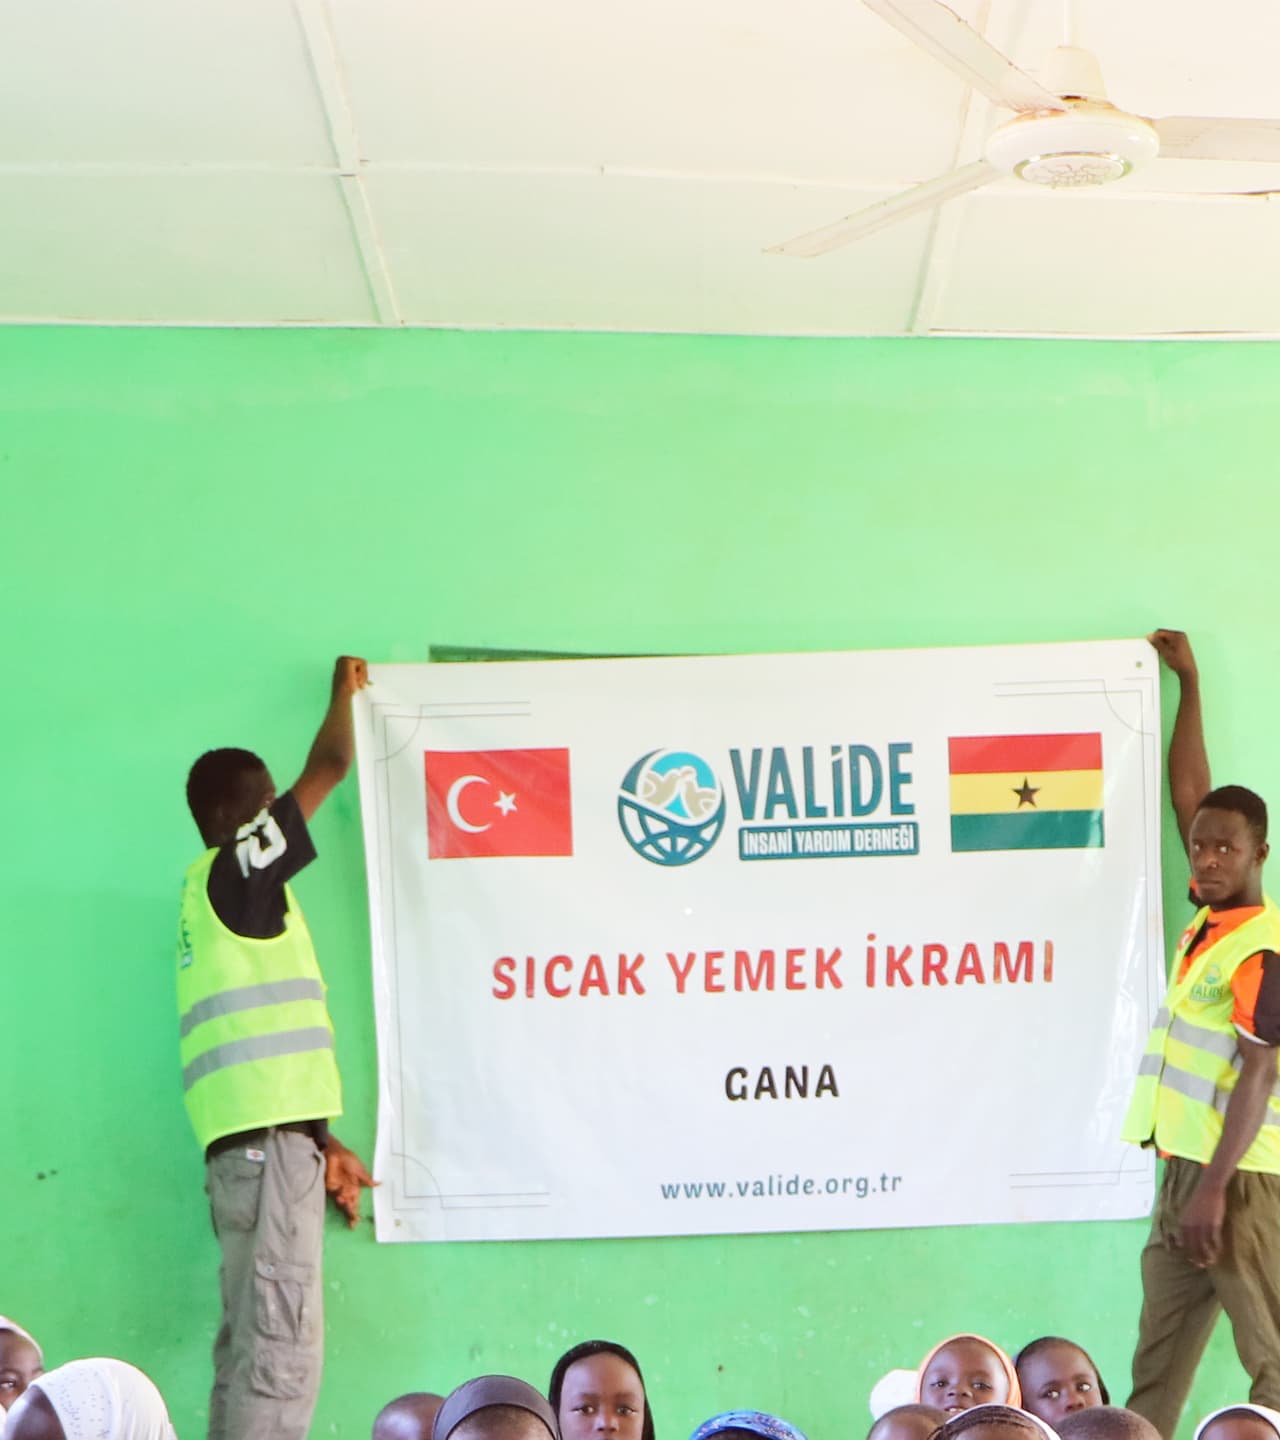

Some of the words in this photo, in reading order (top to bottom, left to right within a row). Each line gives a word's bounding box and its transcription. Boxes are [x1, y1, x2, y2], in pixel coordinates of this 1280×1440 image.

[742, 828, 793, 855] İNSANİ
[795, 826, 851, 853] YARDIM
[854, 823, 915, 851] DERNEĞİ
[492, 953, 646, 1000] SICAK
[666, 947, 843, 994] YEMEK
[865, 932, 1055, 988] İKRAMI
[724, 1064, 840, 1102] GANA
[660, 1173, 902, 1201] www.valide.org.tr
